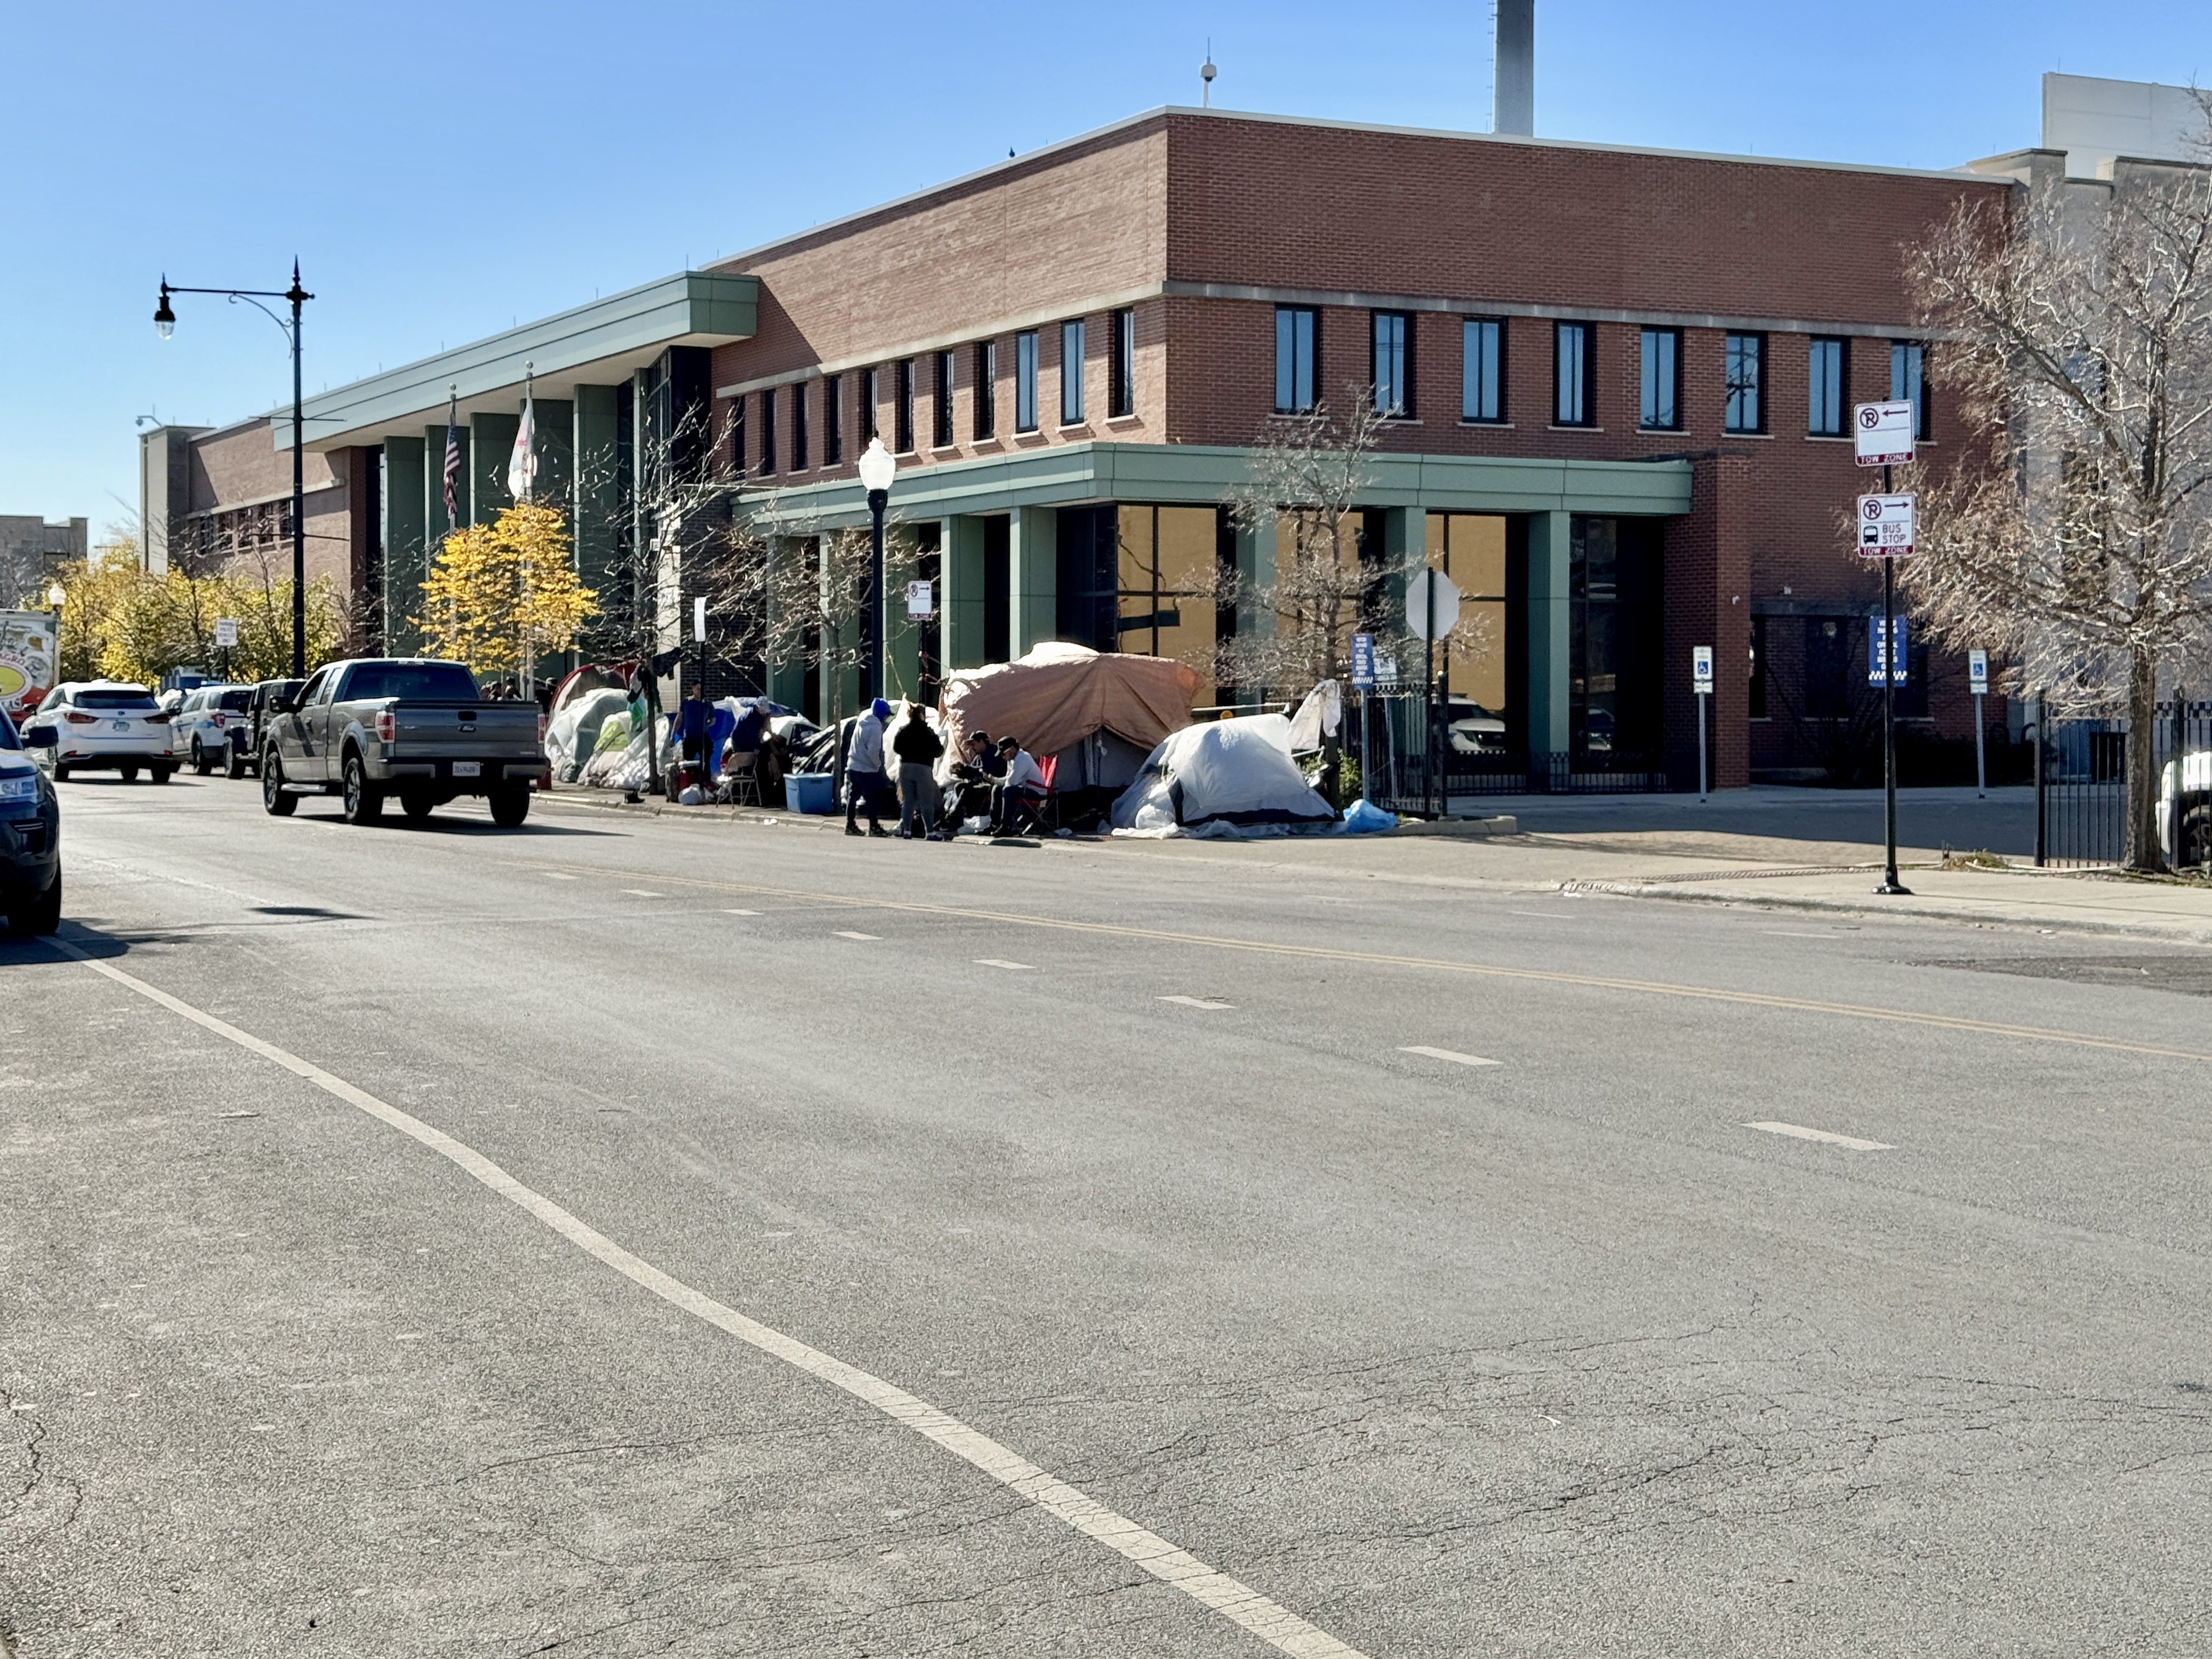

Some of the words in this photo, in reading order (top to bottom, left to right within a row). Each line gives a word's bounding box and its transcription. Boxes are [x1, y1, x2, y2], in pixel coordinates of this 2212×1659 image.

[1860, 455, 1879, 464] TOW
[1884, 454, 1907, 463] ZONE
[1882, 524, 1901, 533] BUS
[1882, 534, 1906, 545] STOP
[1864, 547, 1881, 555] TOW
[1885, 546, 1908, 554] ZONE
